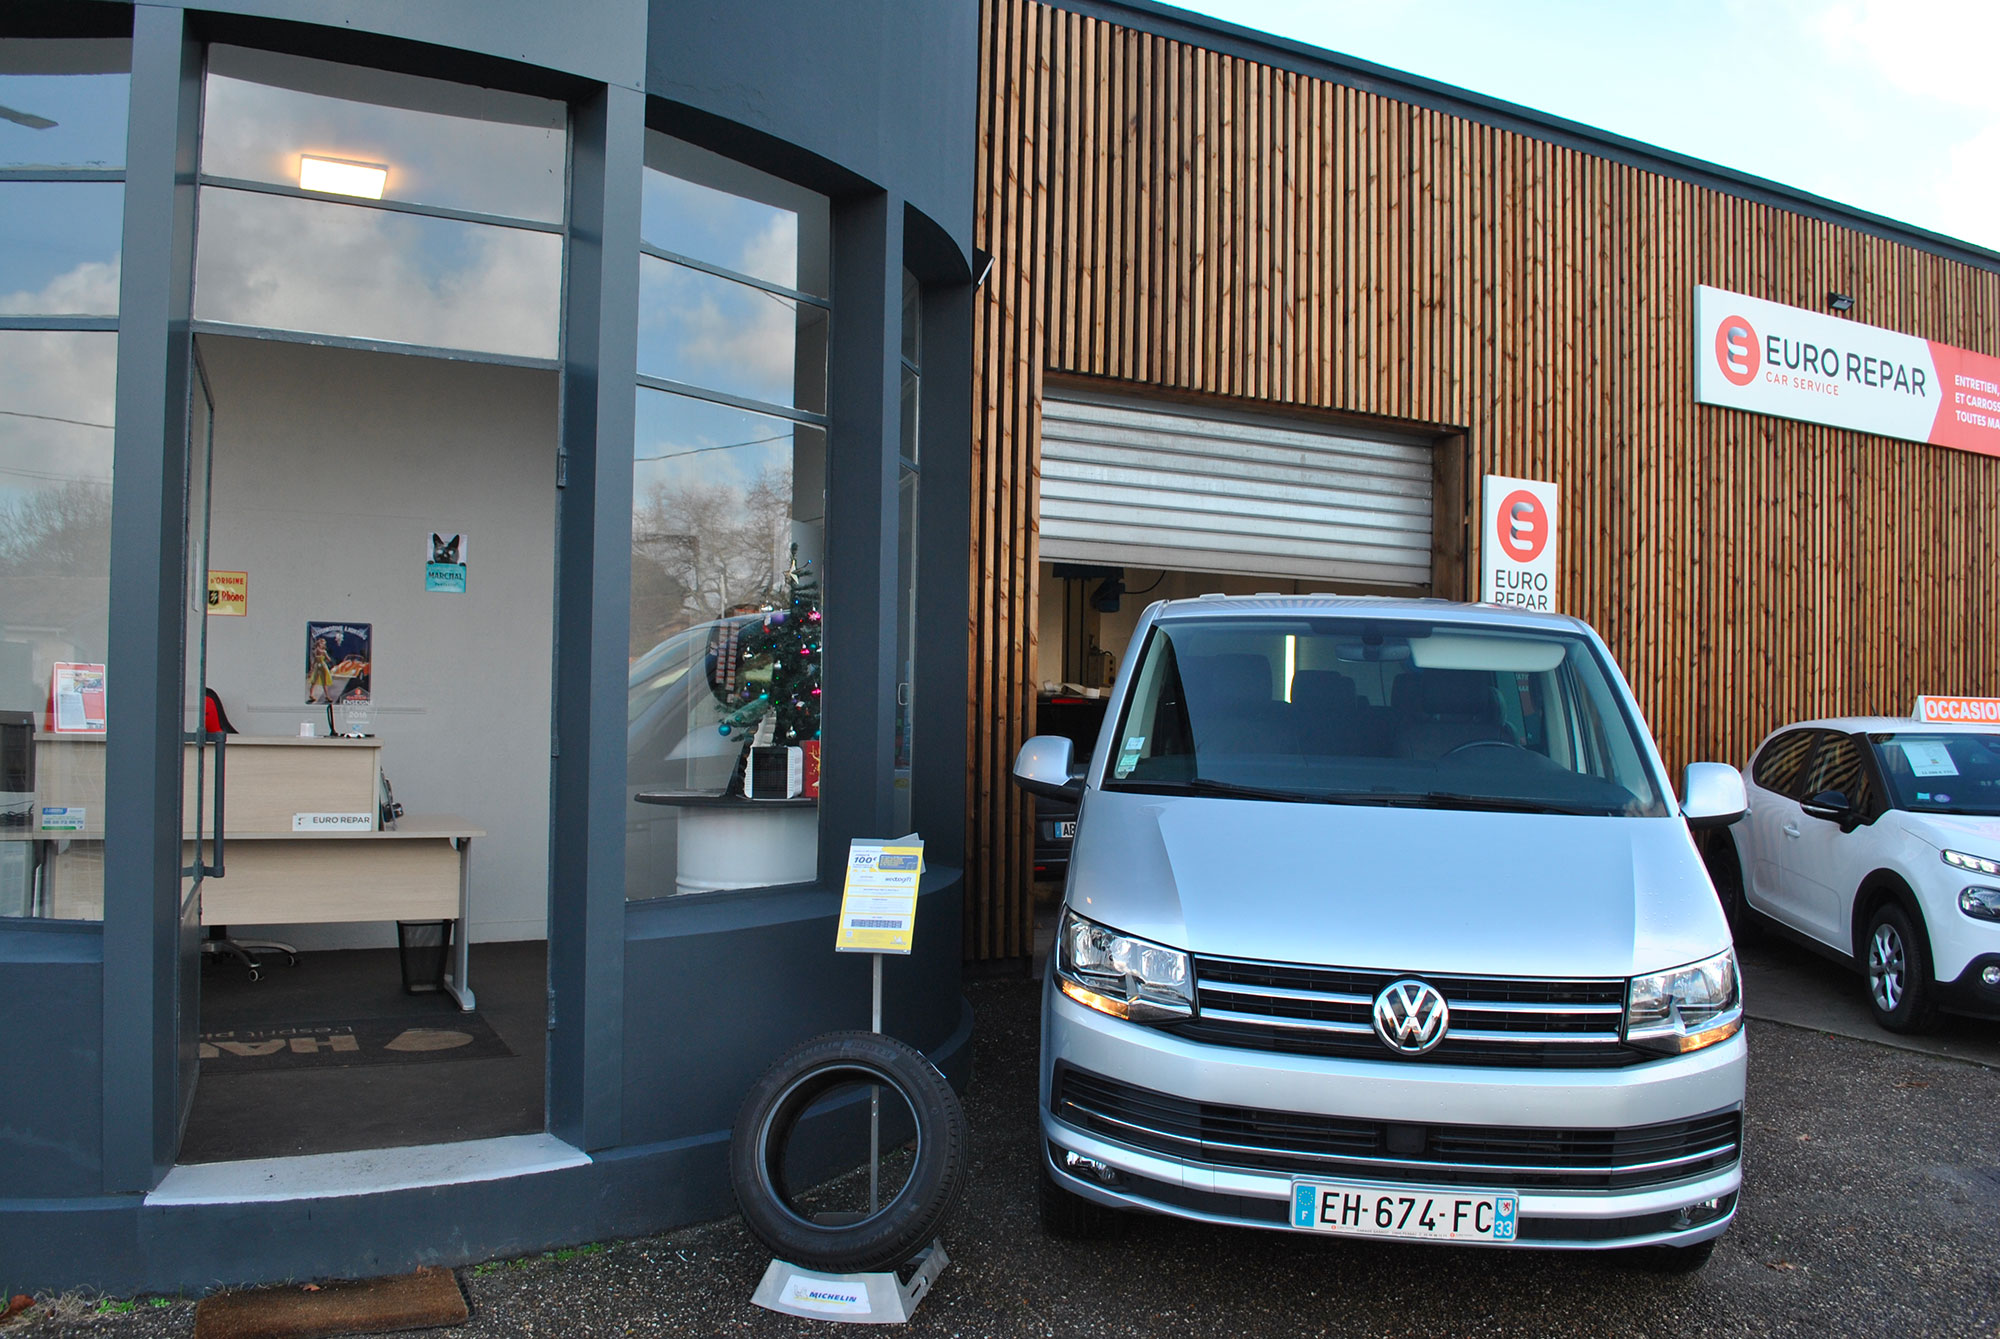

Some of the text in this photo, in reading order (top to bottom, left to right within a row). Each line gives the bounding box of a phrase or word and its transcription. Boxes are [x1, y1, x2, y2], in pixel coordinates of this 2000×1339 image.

[1766, 335, 1926, 398] EURO REPAR
[1765, 371, 1839, 396] CAR SERVICE
[1955, 392, 1965, 404] ET
[1955, 409, 1986, 427] TOUTES
[1495, 569, 1548, 592] EURO
[1495, 591, 1548, 610] REPAR
[312, 816, 370, 824] EURO REPAR
[1301, 1210, 1308, 1221] F
[1319, 1191, 1493, 1234] EH-674-FC
[1494, 1220, 1513, 1237] 33
[809, 1291, 857, 1302] MICHELIN
